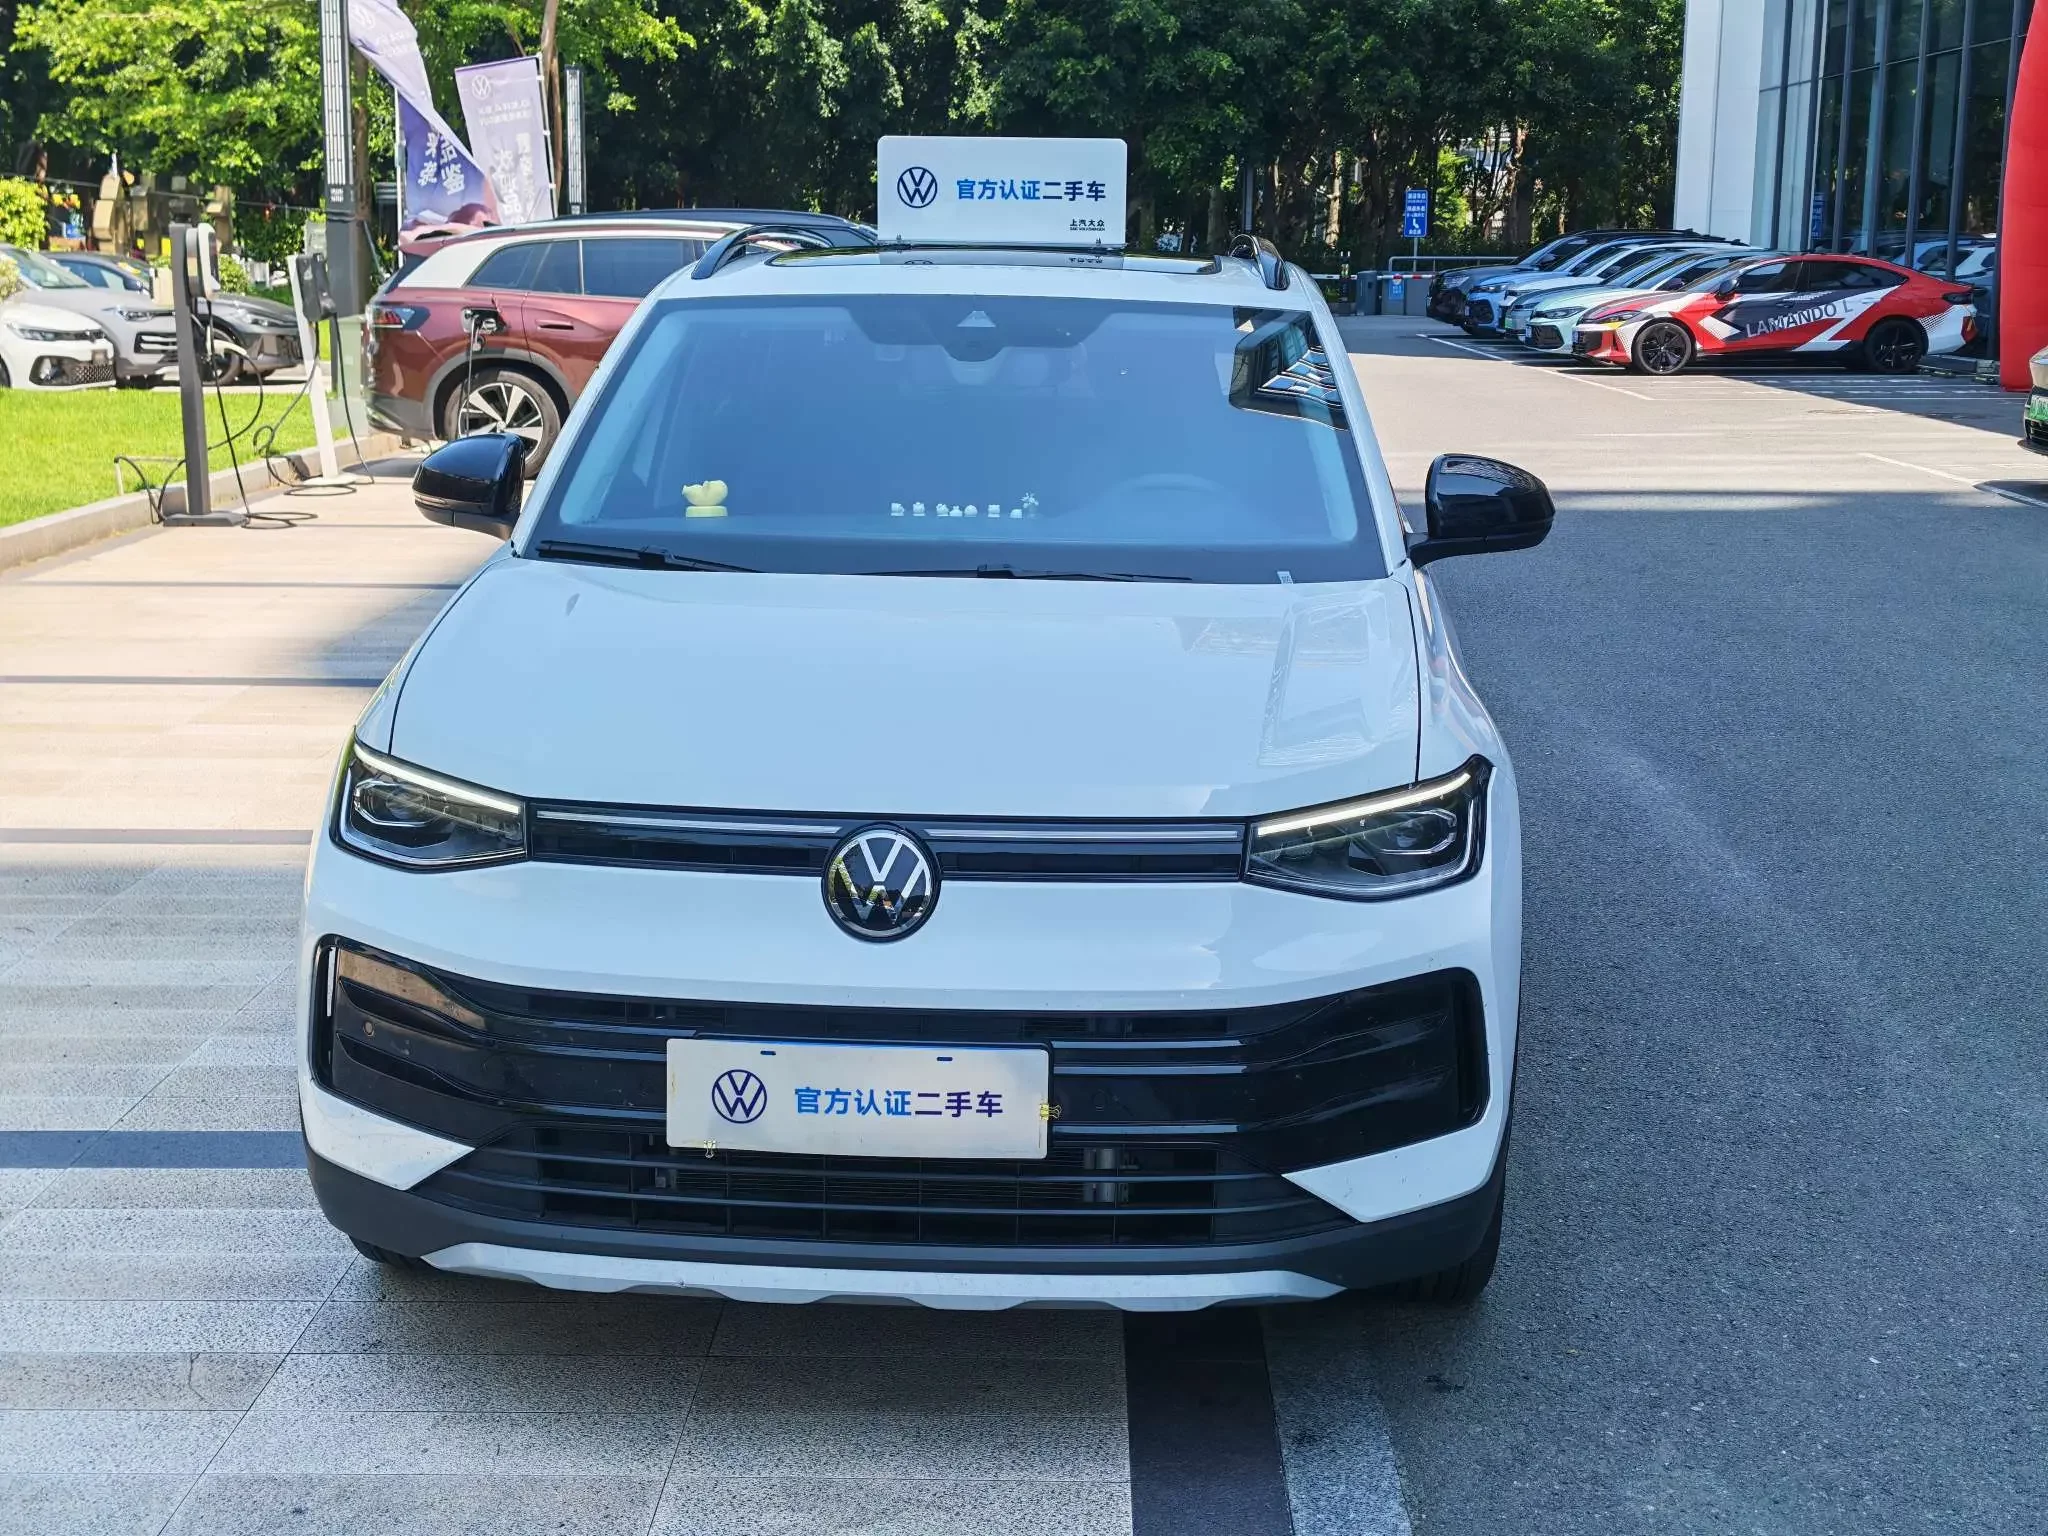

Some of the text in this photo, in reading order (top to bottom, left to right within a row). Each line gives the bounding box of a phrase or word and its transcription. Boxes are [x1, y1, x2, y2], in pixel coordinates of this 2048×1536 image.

[956, 178, 1106, 202] 官方认证二手车
[1069, 218, 1105, 227] 上汽大众
[1746, 300, 1854, 338] LAMANDO L
[794, 1086, 1003, 1118] 官方认证二手车
